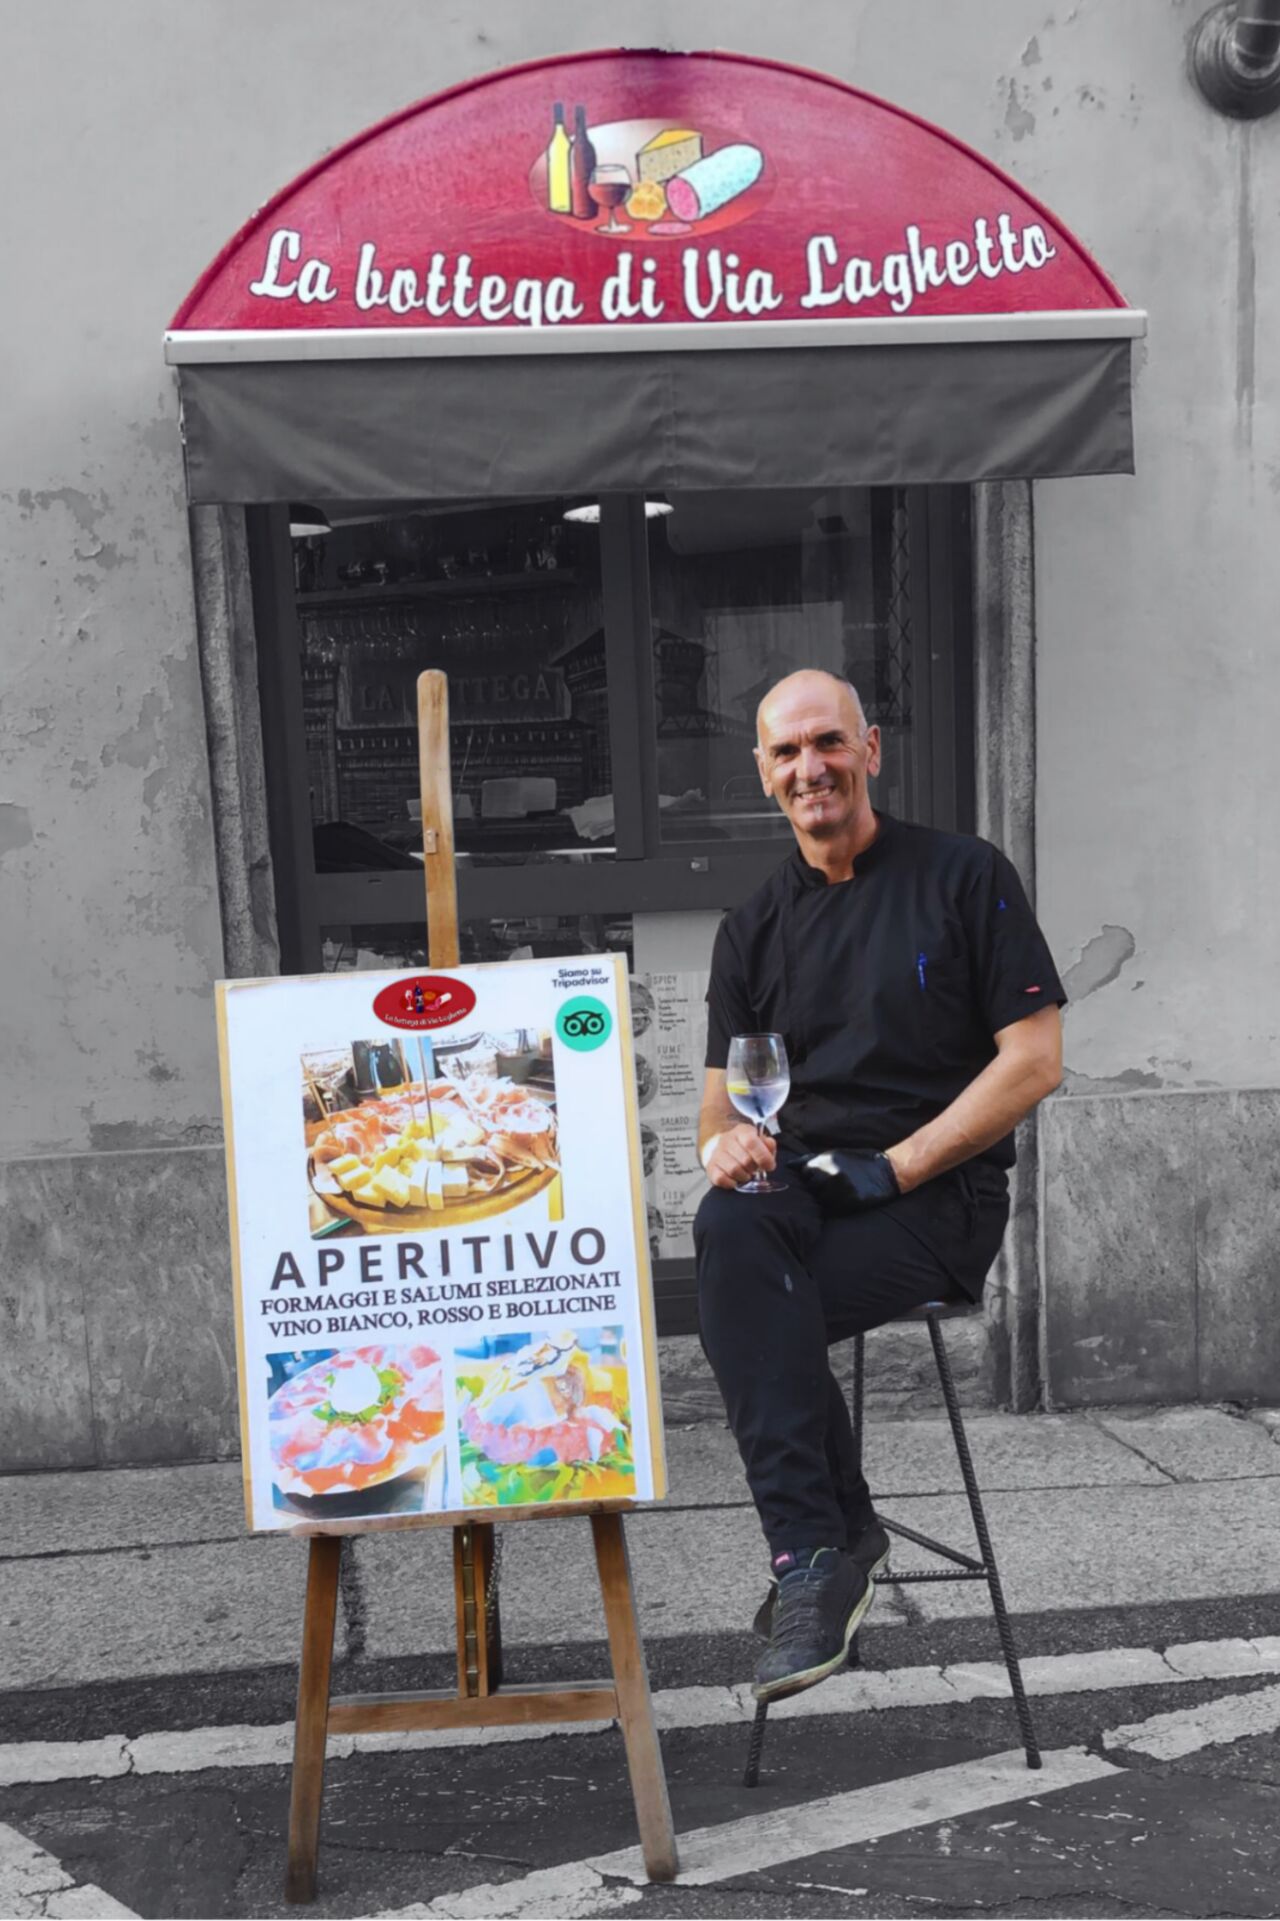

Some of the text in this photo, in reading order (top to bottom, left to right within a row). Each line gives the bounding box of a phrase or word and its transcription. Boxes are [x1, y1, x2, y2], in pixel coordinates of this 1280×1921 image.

[250, 213, 1056, 327] La bottega di Via Laghetto
[360, 684, 394, 712] LA
[552, 976, 610, 989] Tripadvisor
[558, 968, 602, 978] Siamo su
[653, 975, 677, 985] SPICY
[394, 1015, 419, 1027] bottega
[439, 1007, 467, 1022] Laghetto
[661, 1116, 690, 1127] SALATO
[270, 1226, 606, 1290] APERITIVO
[260, 1271, 621, 1315] FORMAGGI E SALUMI SELEZIONATI
[268, 1295, 616, 1338] VINO BIANCO, ROSSO E BOLLICINE
